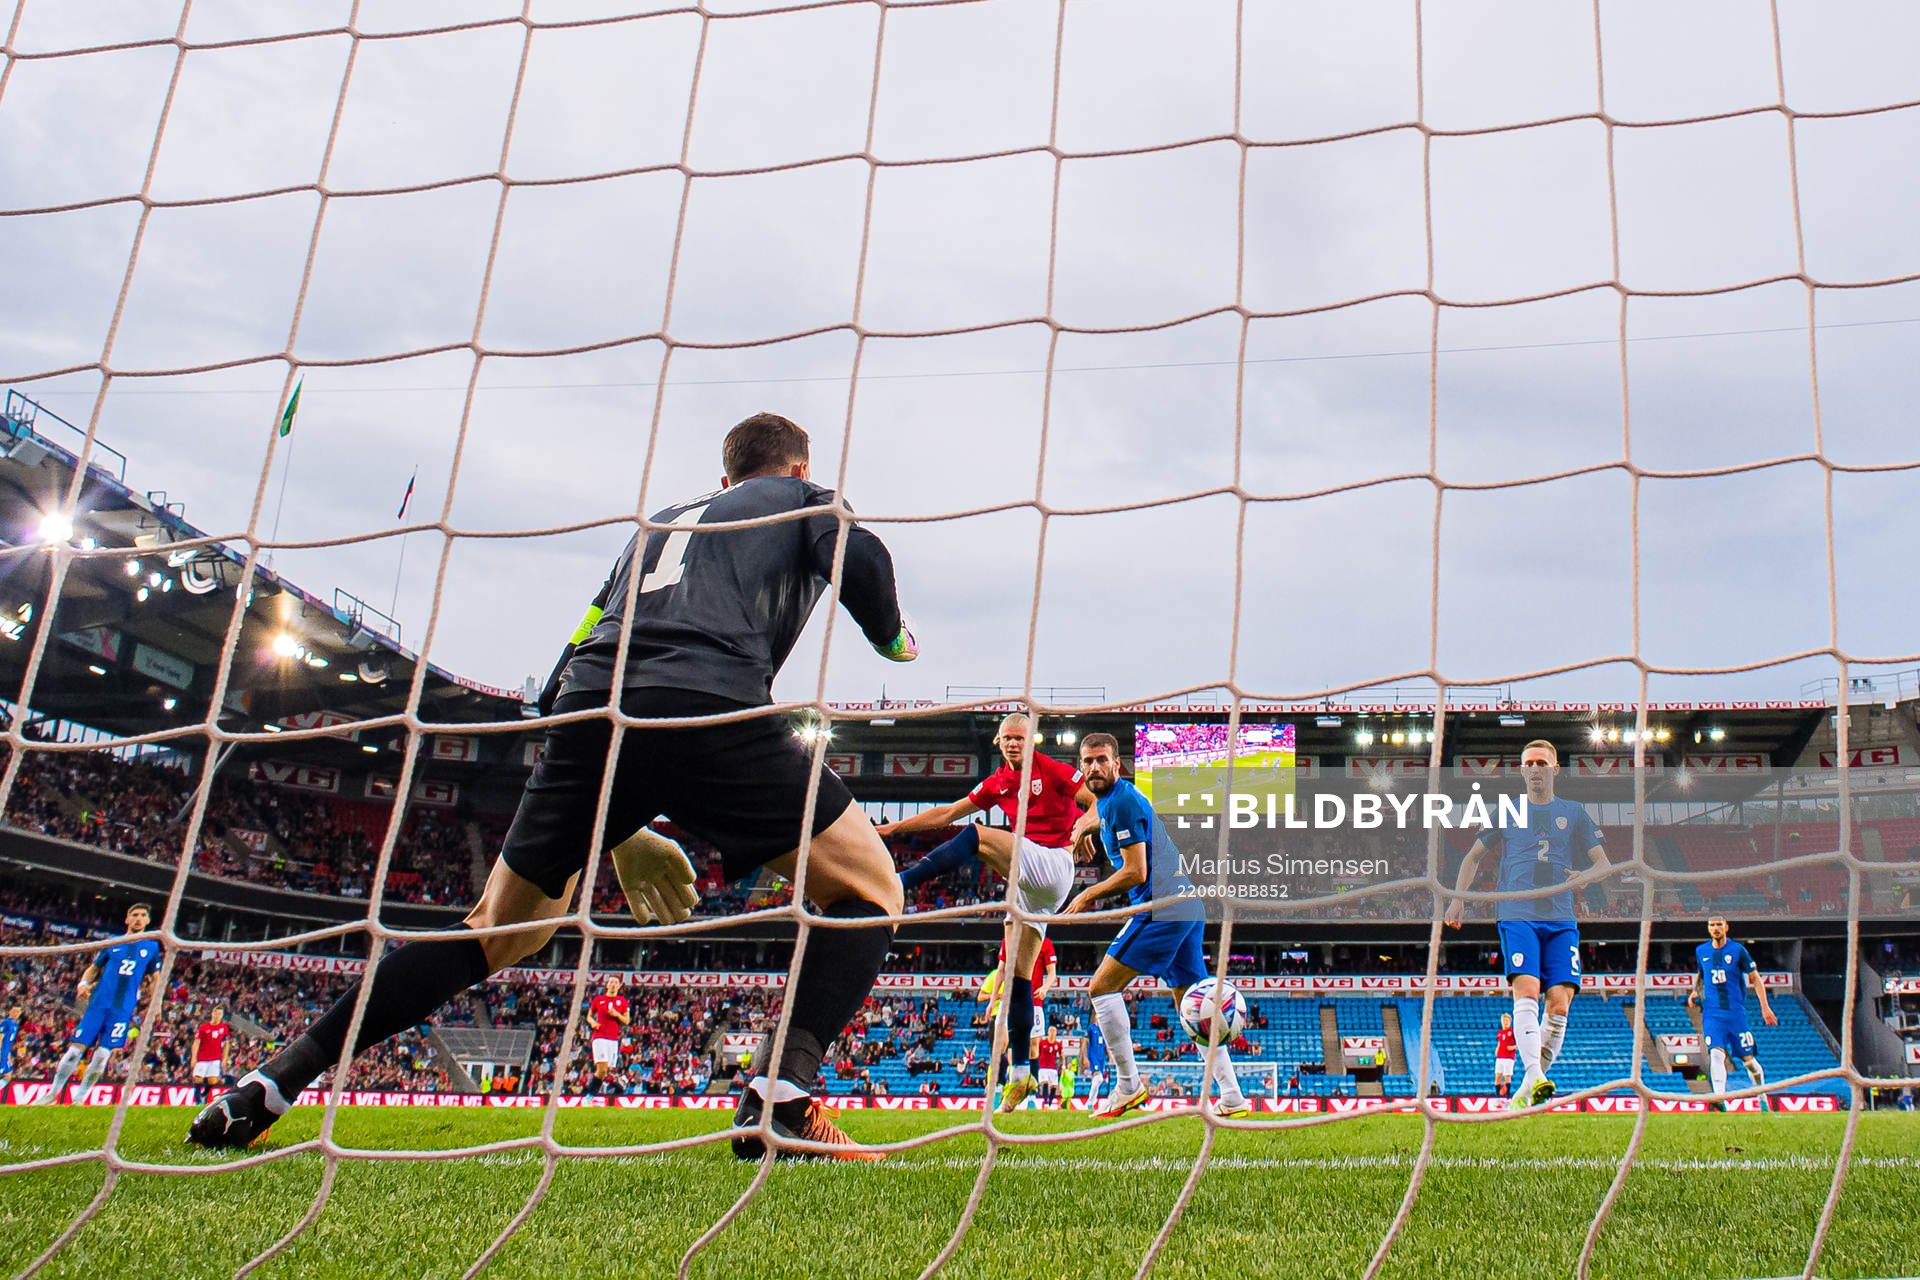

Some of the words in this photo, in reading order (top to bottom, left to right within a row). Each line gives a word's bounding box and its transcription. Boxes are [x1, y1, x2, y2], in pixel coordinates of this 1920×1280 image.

[640, 504, 711, 594] 1
[895, 756, 967, 774] VG
[1689, 755, 1762, 773] VG
[1821, 746, 1897, 767] VG
[260, 761, 332, 788] VG
[1356, 758, 1426, 775] VG
[1537, 840, 1550, 862] 2
[118, 959, 136, 976] 22
[251, 953, 282, 968] VG
[291, 957, 324, 971] VG
[634, 974, 671, 984] VG
[682, 974, 719, 984] VG
[730, 975, 767, 985] VG
[876, 977, 913, 986] VG
[924, 977, 961, 986] VG
[1265, 978, 1303, 988] VG
[1314, 978, 1352, 988] VG
[1363, 978, 1400, 988] VG
[1411, 978, 1449, 987] VG
[1460, 978, 1498, 987] VG
[1653, 976, 1691, 986] VG
[1711, 970, 1727, 984] 20
[110, 1022, 126, 1038] 22
[727, 1033, 763, 1046] VG
[1344, 1038, 1384, 1049] VG
[1662, 1036, 1699, 1046] VG
[1739, 1031, 1755, 1048] 20
[121, 1086, 162, 1106] VG
[356, 1093, 380, 1106] VG
[385, 1094, 409, 1106] VG
[413, 1095, 435, 1106] VG
[438, 1095, 459, 1107] VG
[463, 1095, 483, 1107] VG
[489, 1096, 541, 1107] VG
[618, 1096, 670, 1109] VG
[680, 1096, 734, 1109] VG
[876, 1097, 928, 1110] VG
[1264, 1098, 1318, 1112] VG
[1329, 1098, 1382, 1112] VG
[1588, 1097, 1640, 1112] VG
[1651, 1098, 1705, 1112] VG
[1780, 1097, 1833, 1111] VG
